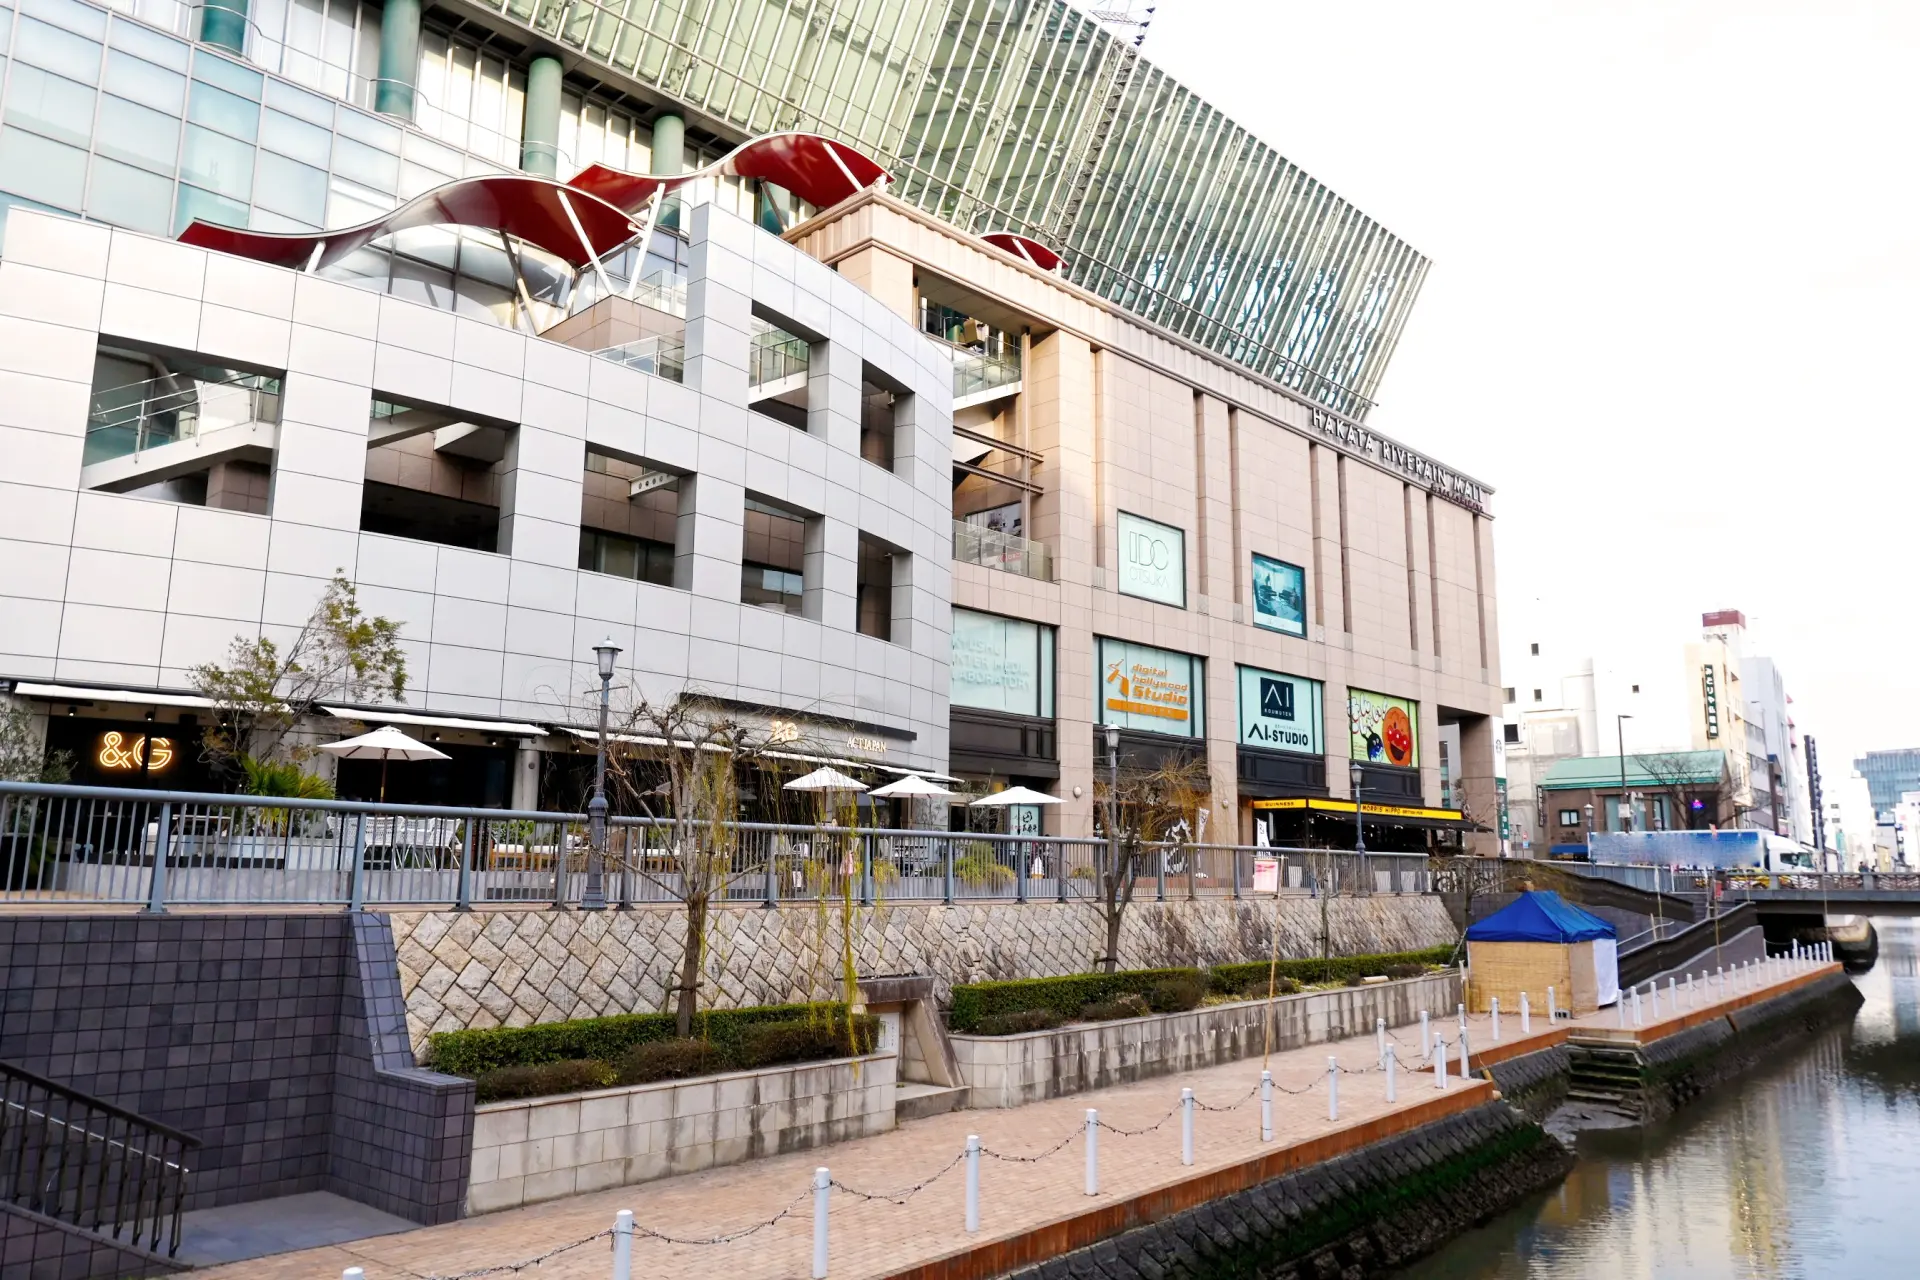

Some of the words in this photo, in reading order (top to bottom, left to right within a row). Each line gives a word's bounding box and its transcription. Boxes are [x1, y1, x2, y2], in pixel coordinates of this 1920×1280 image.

[1312, 408, 1374, 452] HAKATA
[1381, 441, 1447, 487] RIVERAIN
[1453, 476, 1484, 503] MALL
[1129, 530, 1169, 571] IDC
[1130, 568, 1170, 589] OTSUKA
[1132, 664, 1167, 678] digital
[1133, 674, 1188, 692] hollywood
[99, 731, 173, 770] &G
